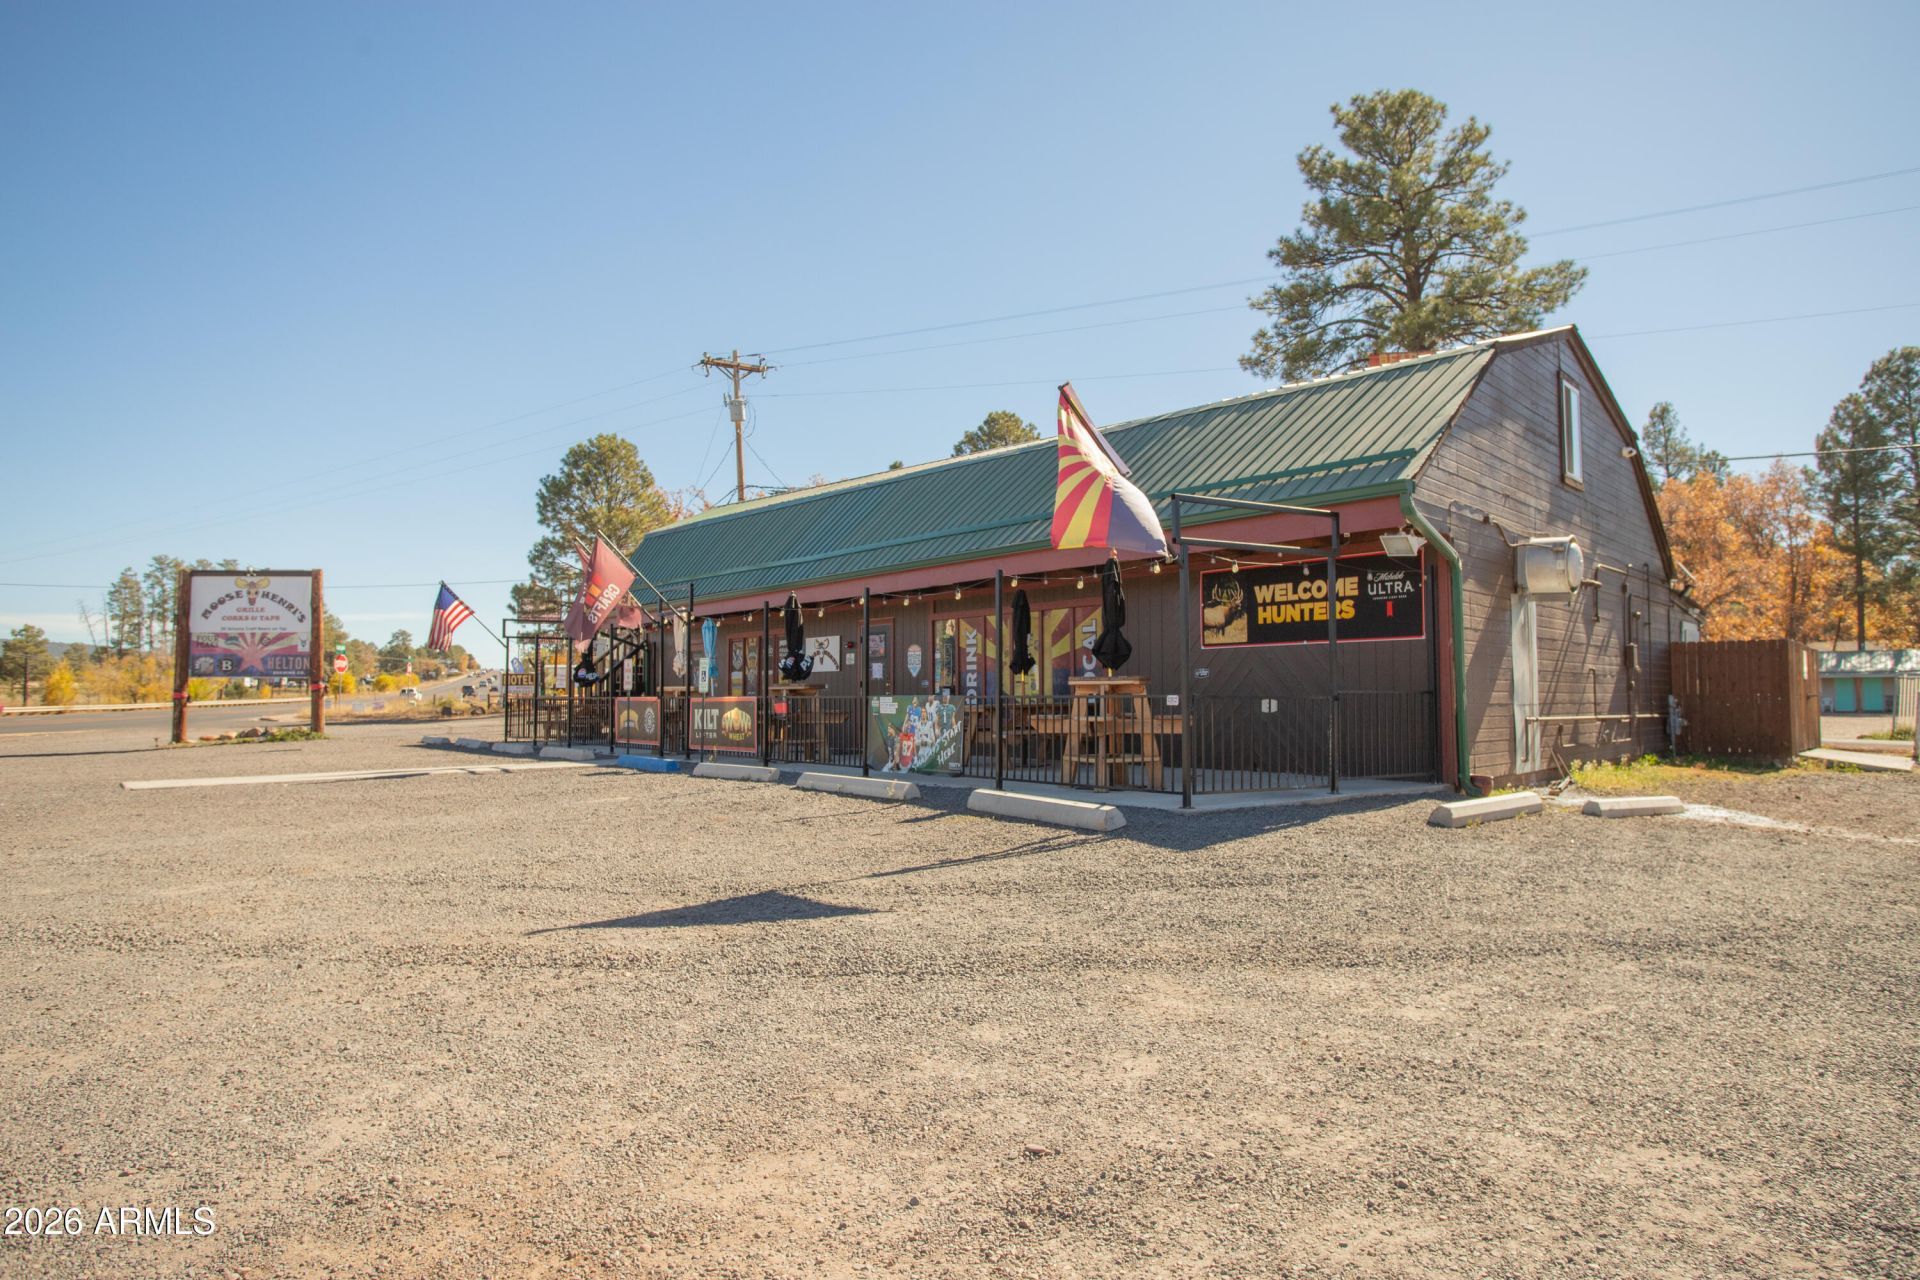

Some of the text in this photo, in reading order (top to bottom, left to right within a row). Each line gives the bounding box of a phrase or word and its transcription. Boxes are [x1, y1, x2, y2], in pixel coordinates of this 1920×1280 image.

[1368, 580, 1414, 595] ULTRA
[201, 590, 306, 623] MOOSE HENRI'S
[1257, 599, 1356, 625] HUNTERS
[222, 660, 233, 671] B
[267, 655, 310, 670] HELTON
[965, 629, 978, 705] DRINK
[694, 709, 719, 730] KILT
[902, 740, 914, 756] 87
